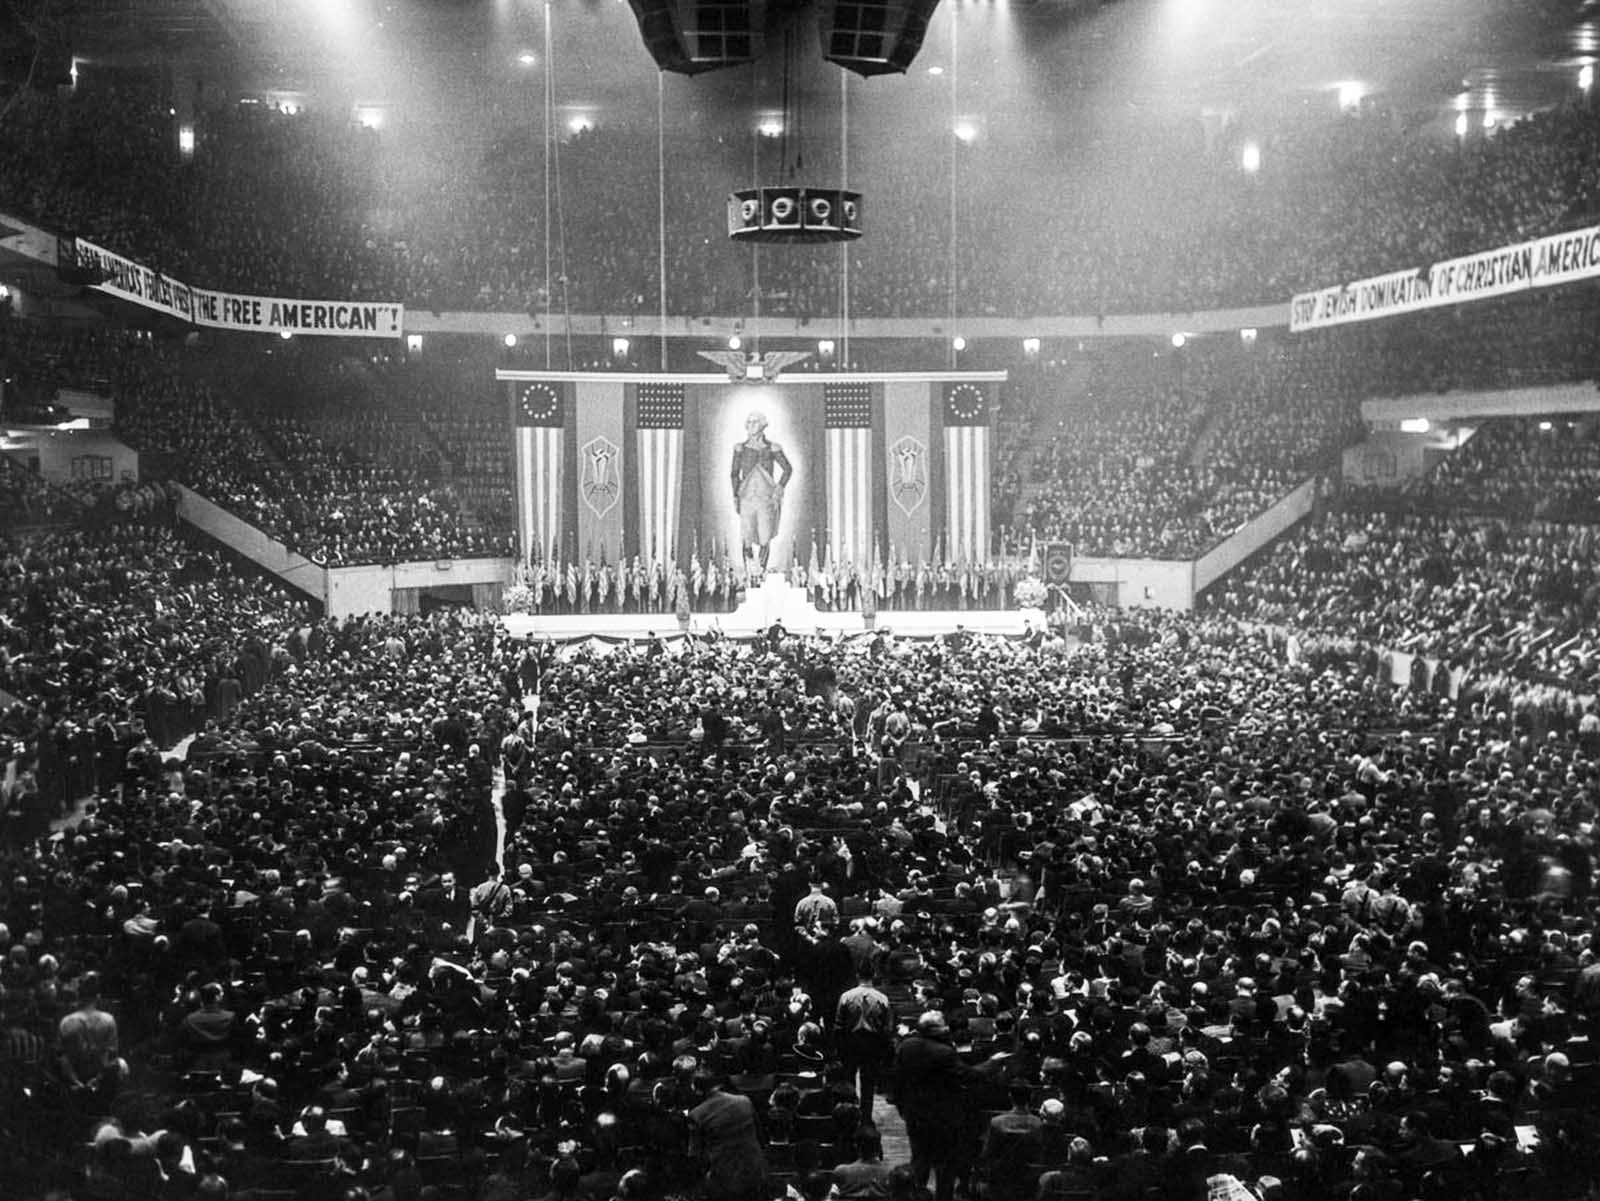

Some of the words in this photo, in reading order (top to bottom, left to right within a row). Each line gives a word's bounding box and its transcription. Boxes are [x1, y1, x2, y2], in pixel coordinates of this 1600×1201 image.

[224, 297, 262, 325] FREE
[1294, 296, 1317, 324] STOP
[1319, 286, 1356, 319] JEWISH
[1437, 265, 1455, 297] OF
[1455, 246, 1532, 293] CHRISTIAN
